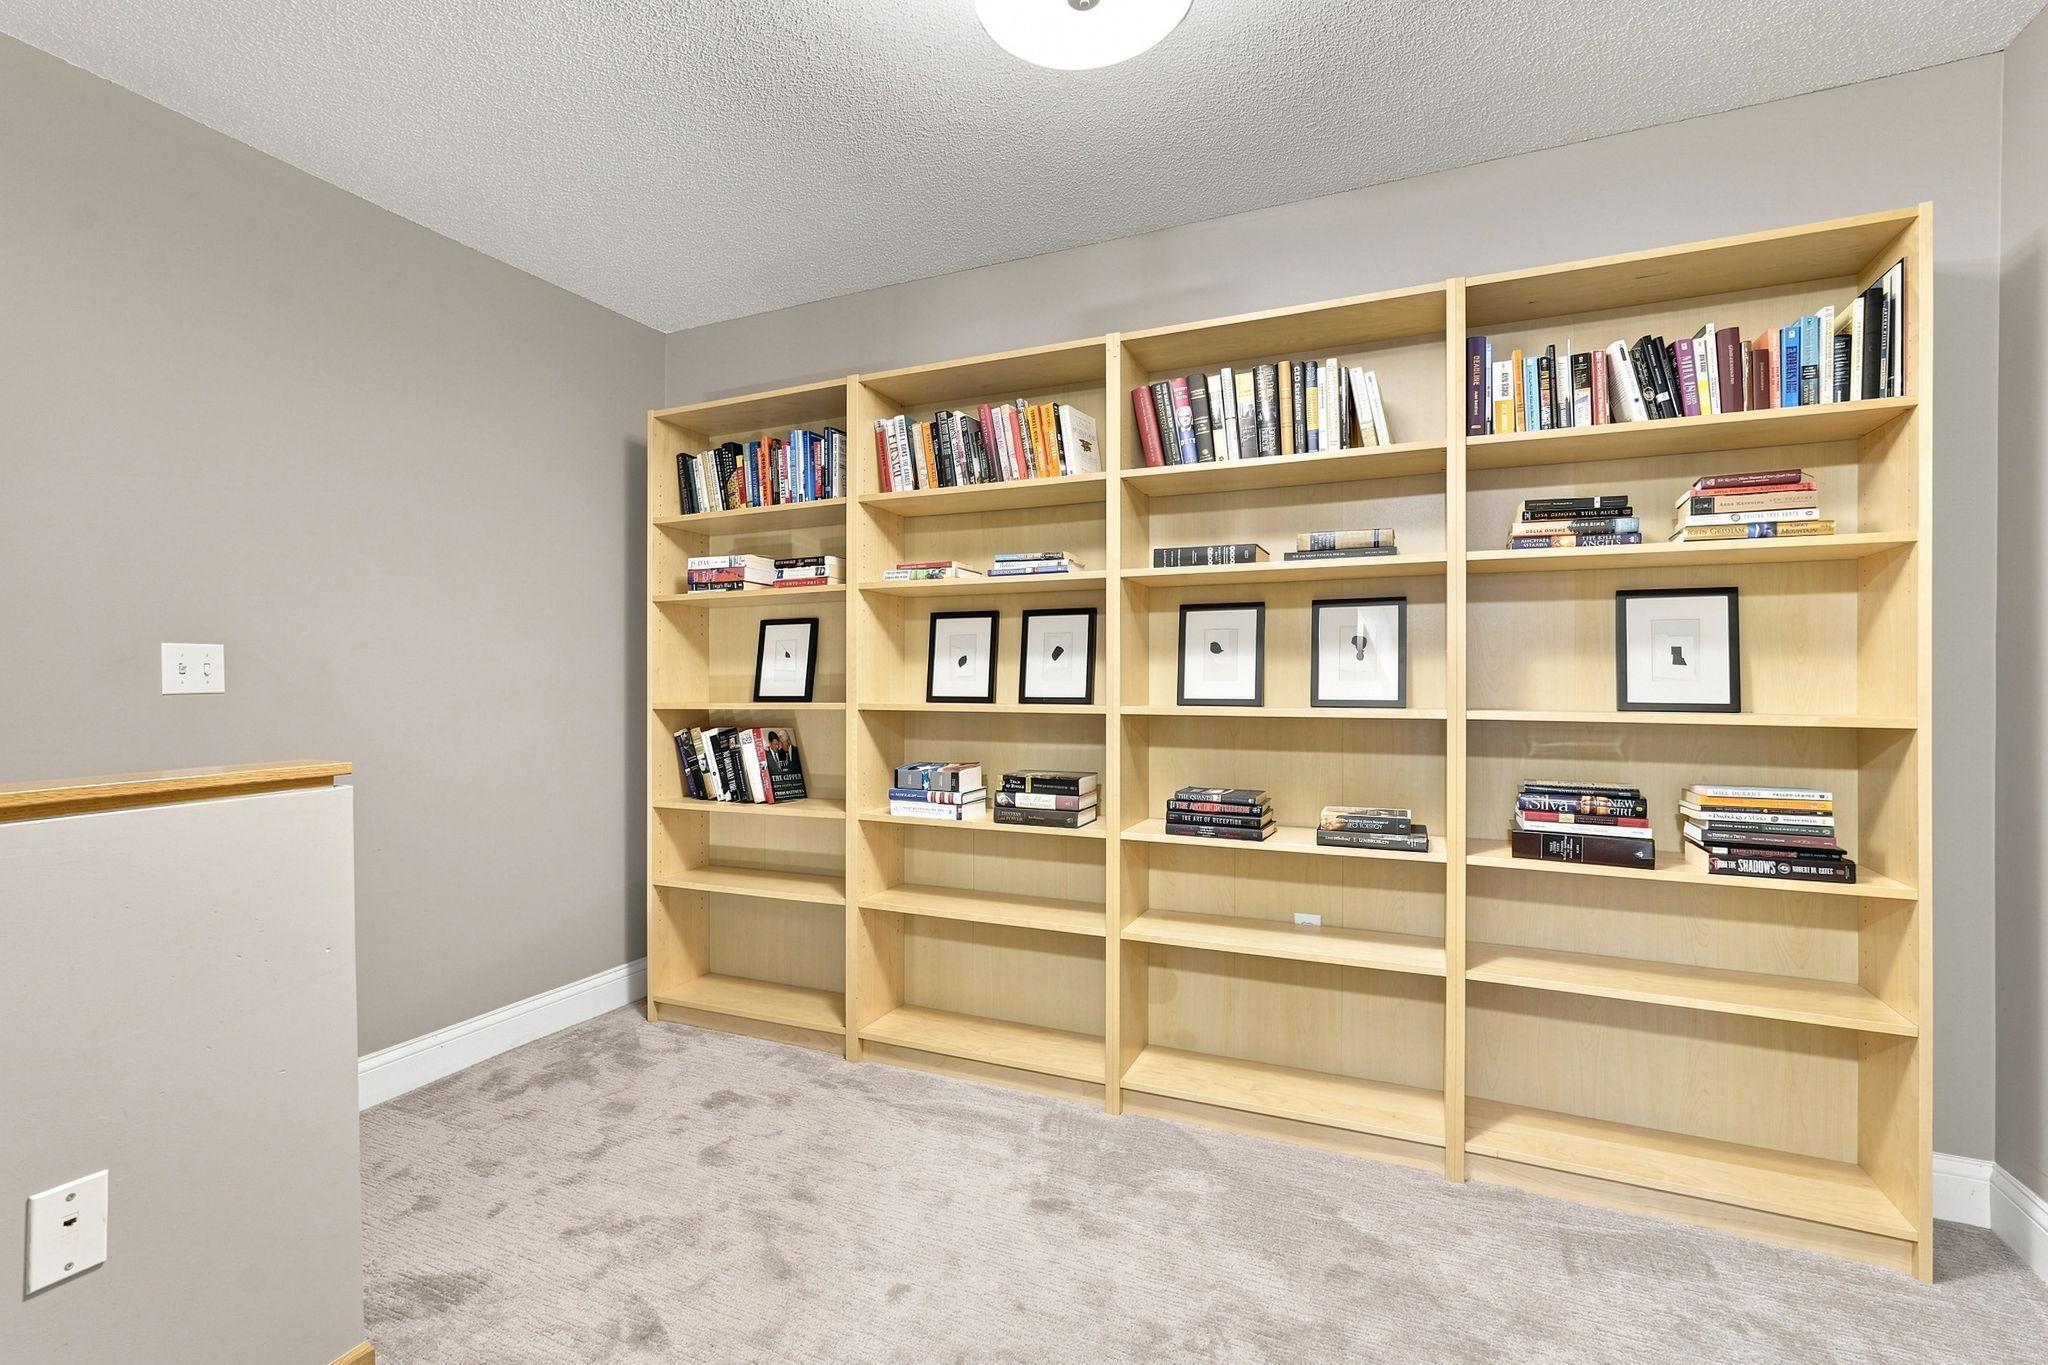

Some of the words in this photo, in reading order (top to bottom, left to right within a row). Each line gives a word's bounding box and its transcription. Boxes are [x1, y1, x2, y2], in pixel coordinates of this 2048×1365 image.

[1785, 345, 1798, 380] EXODUS
[1472, 355, 1480, 385] DEADLINE
[1293, 382, 1303, 420] Excellence
[888, 434, 900, 478] FIASCO
[1709, 526, 1745, 535] GRISHAM
[1581, 539, 1620, 547] ANGELS
[1529, 794, 1568, 812] Silva
[1608, 799, 1636, 809] NEW
[1608, 807, 1636, 817] GIRL
[1212, 817, 1241, 825] DECEPTION
[1358, 837, 1389, 845] UNBROKEN
[1714, 859, 1727, 868] FROM
[1727, 860, 1736, 868] THE
[1737, 859, 1775, 874] SHADOWS
